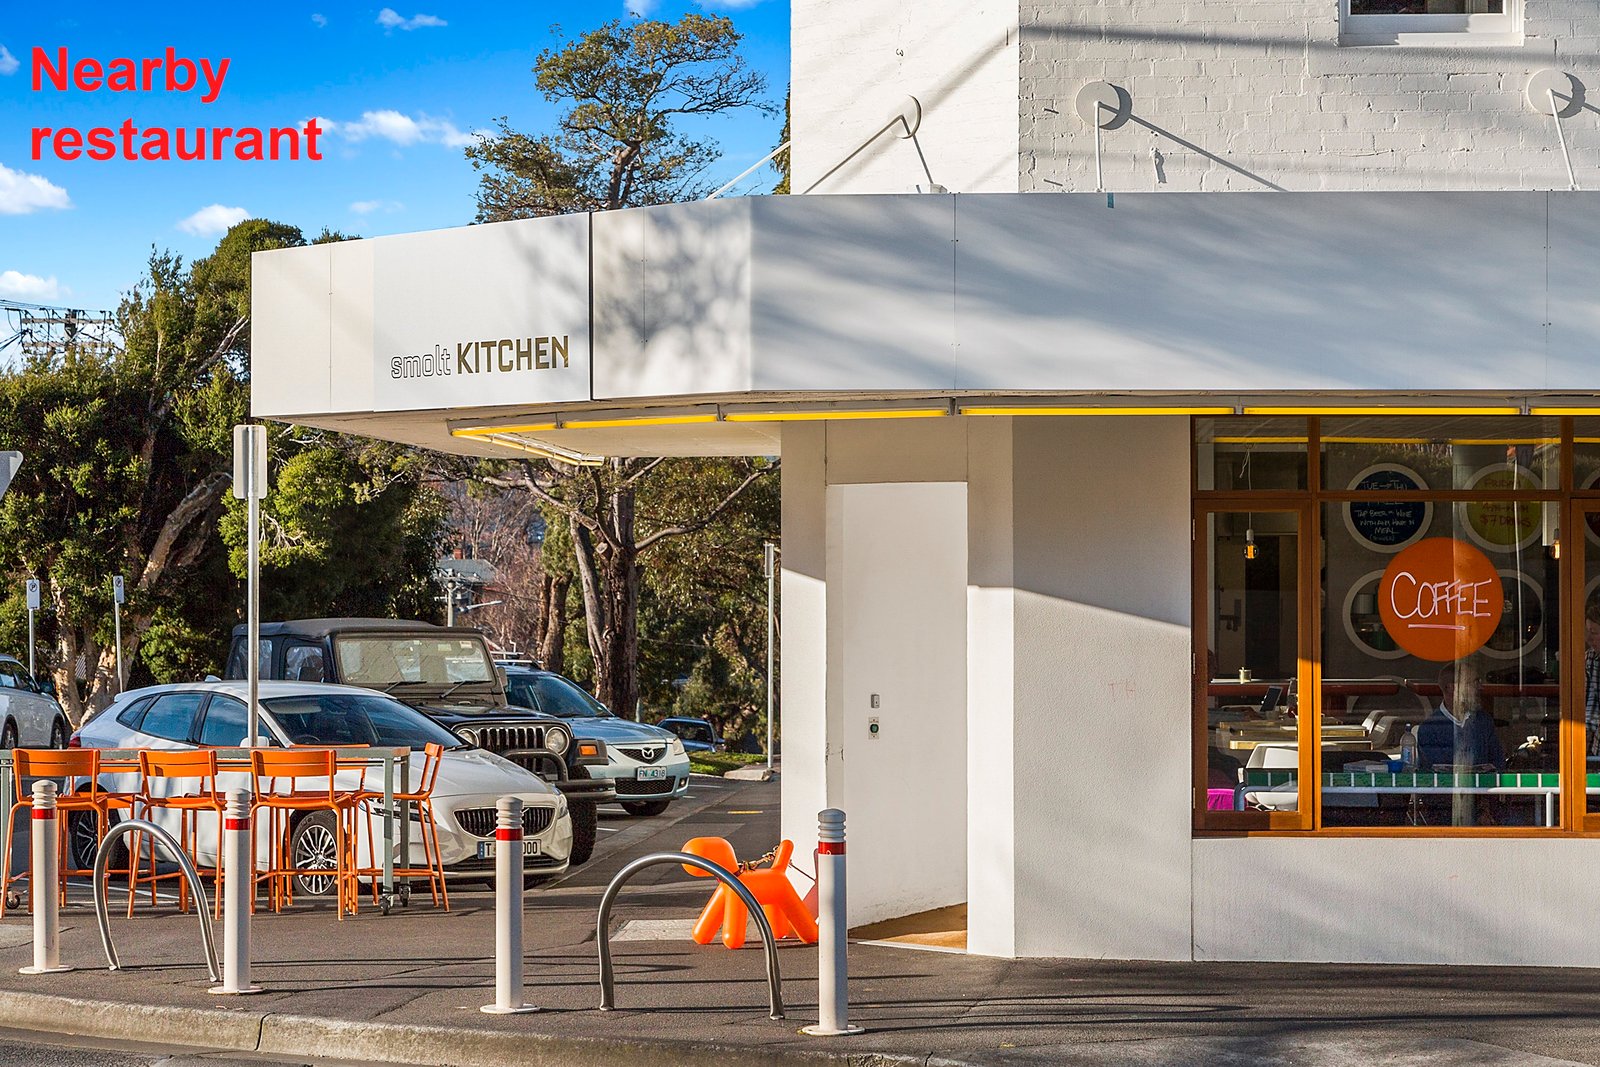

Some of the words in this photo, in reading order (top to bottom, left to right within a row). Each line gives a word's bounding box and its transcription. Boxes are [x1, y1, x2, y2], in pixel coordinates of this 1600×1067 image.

[390, 343, 452, 379] smolt
[457, 335, 569, 375] KITCHEN
[1390, 571, 1492, 618] COFFEE
